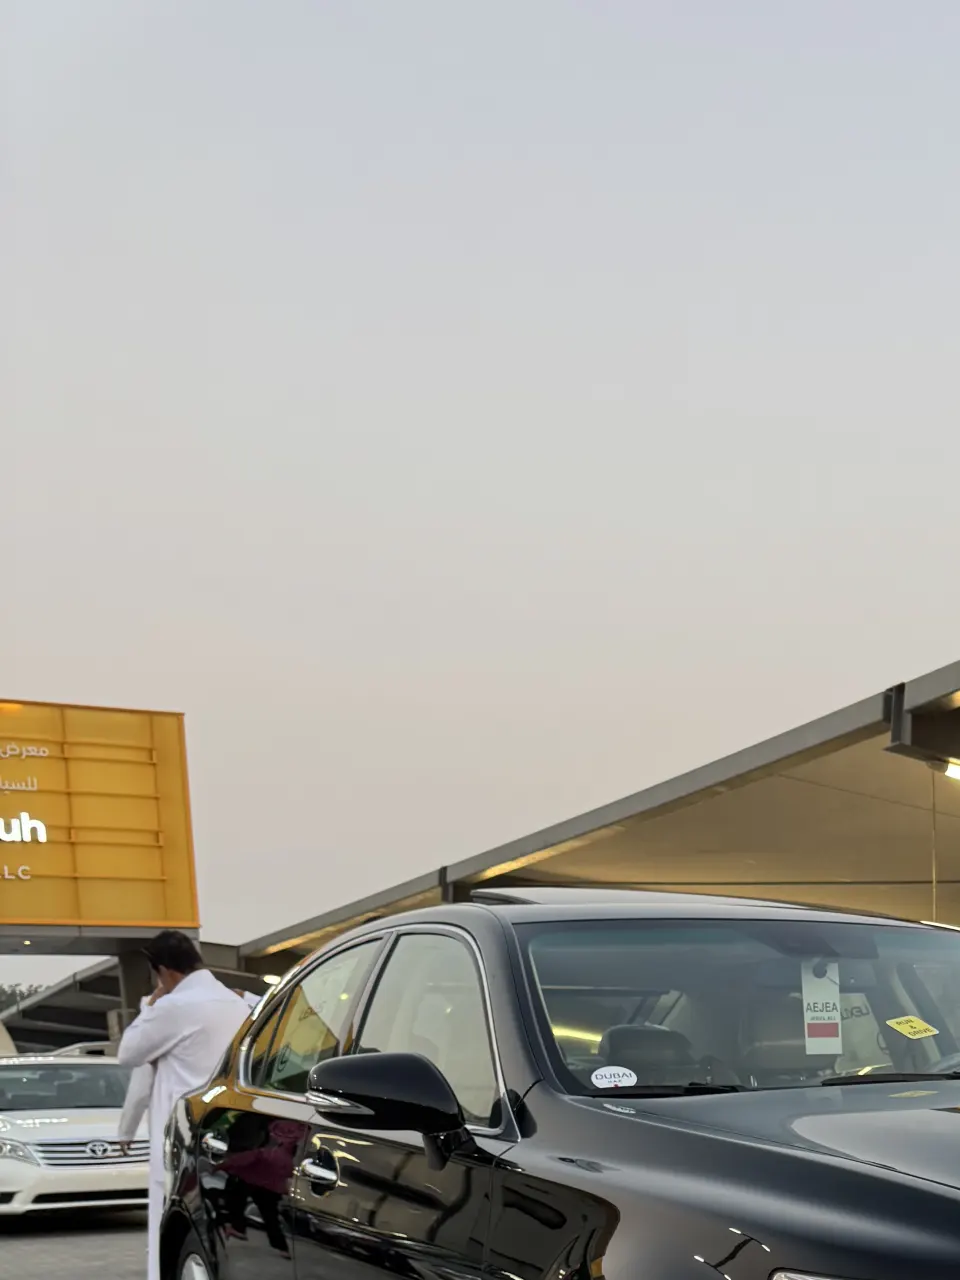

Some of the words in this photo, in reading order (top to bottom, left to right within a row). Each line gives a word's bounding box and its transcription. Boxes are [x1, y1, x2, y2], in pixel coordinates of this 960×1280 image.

[0, 865, 31, 880] LC
[806, 1002, 838, 1013] AEJEA
[595, 1072, 632, 1080] DUBAI
